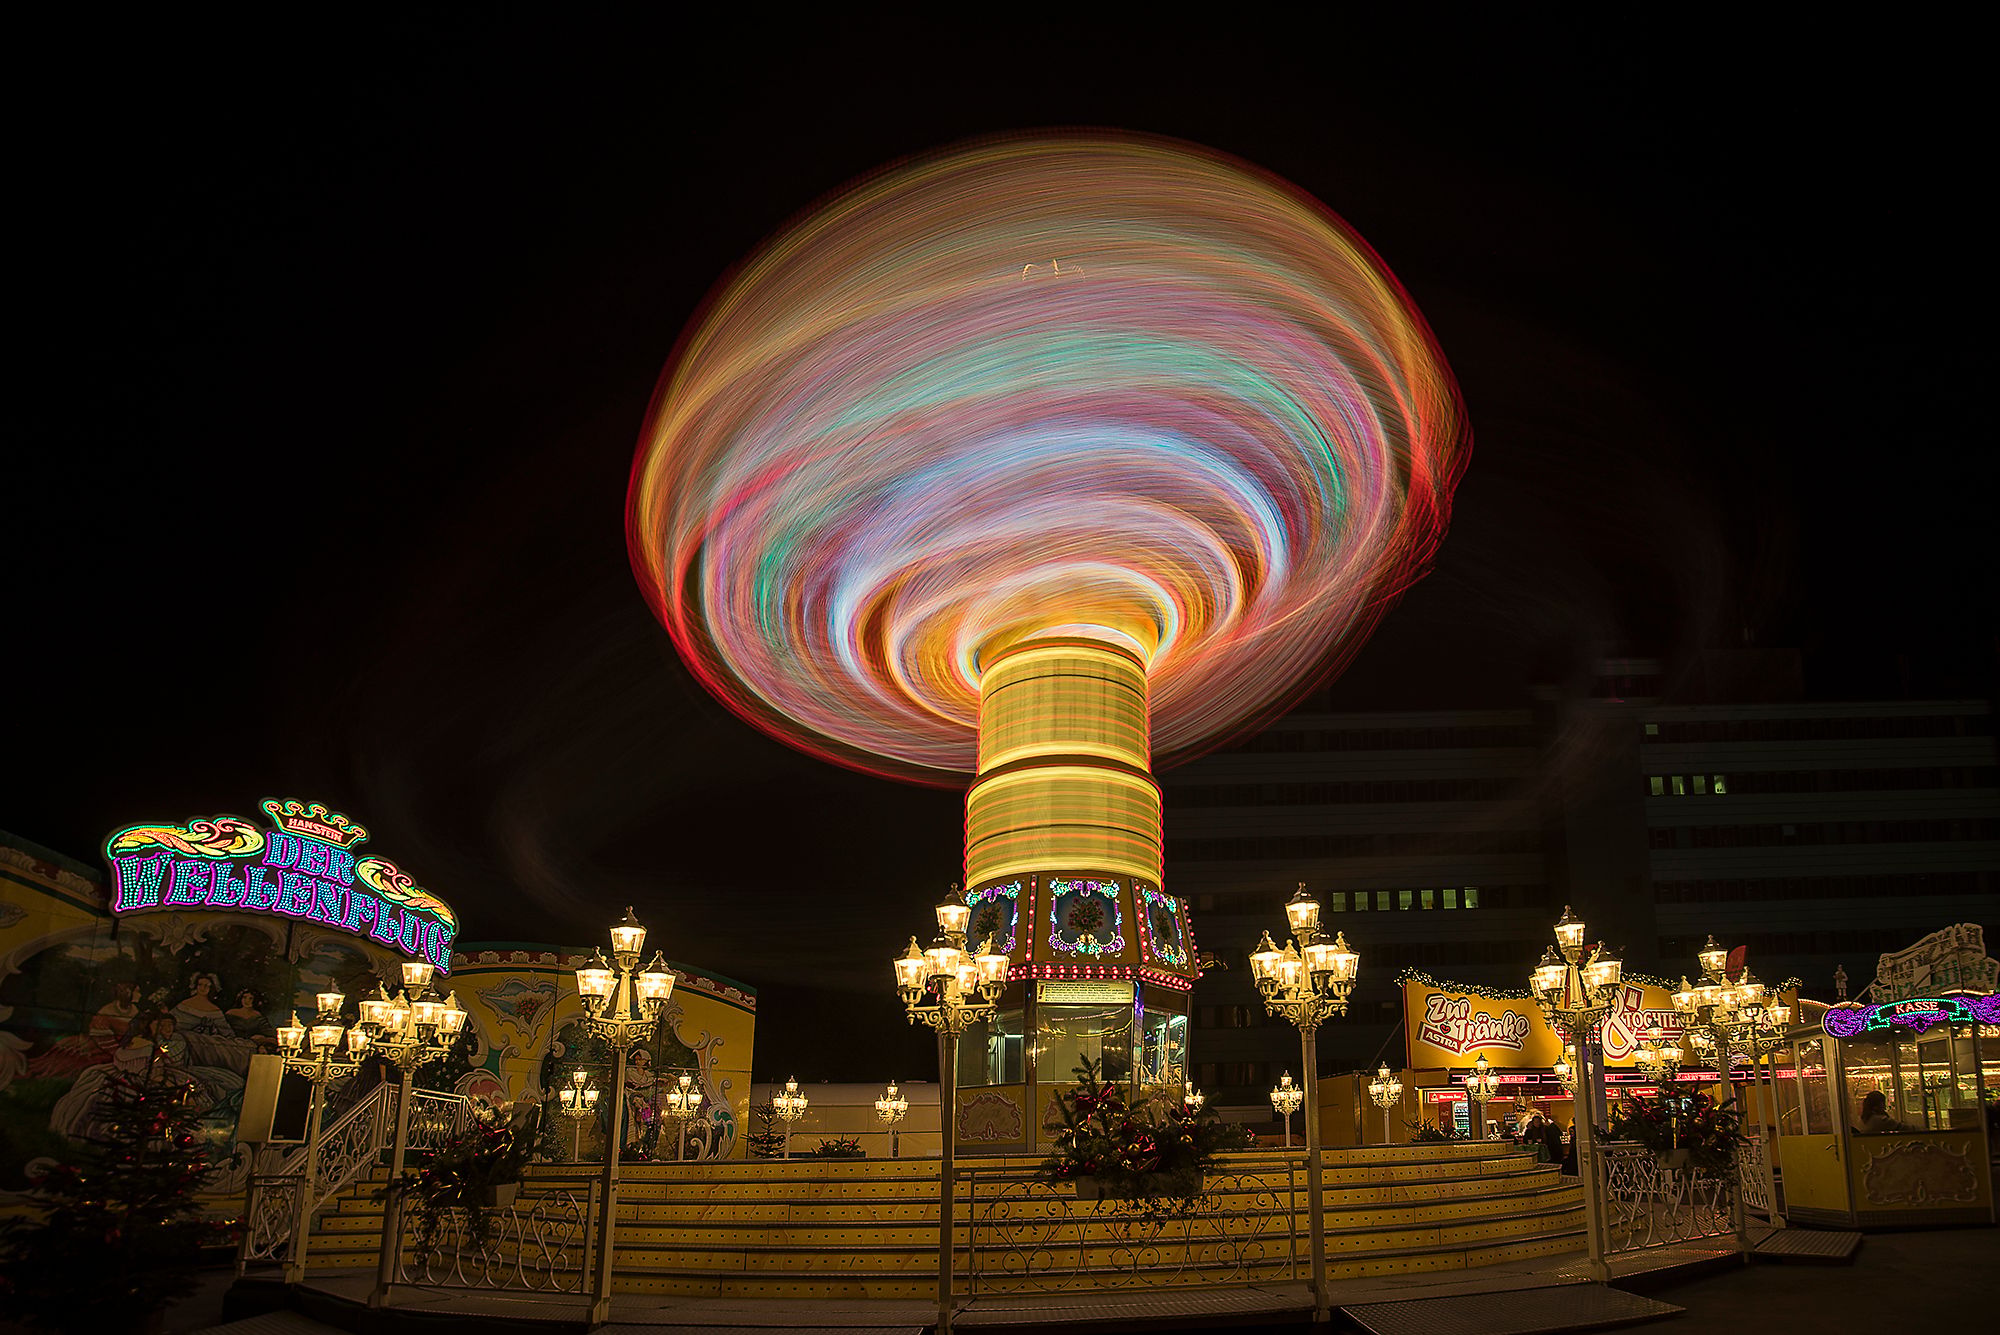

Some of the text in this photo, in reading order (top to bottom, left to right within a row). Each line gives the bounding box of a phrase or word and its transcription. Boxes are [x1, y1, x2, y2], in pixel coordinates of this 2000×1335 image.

[287, 818, 344, 843] HANSTEIN
[262, 831, 356, 888] DER
[112, 852, 455, 975] WELLENFLUG
[1428, 996, 1471, 1022] Zur
[1895, 1001, 1940, 1014] KASSE
[1456, 1010, 1530, 1042] Tränke
[1425, 1031, 1459, 1050] ASTRA
